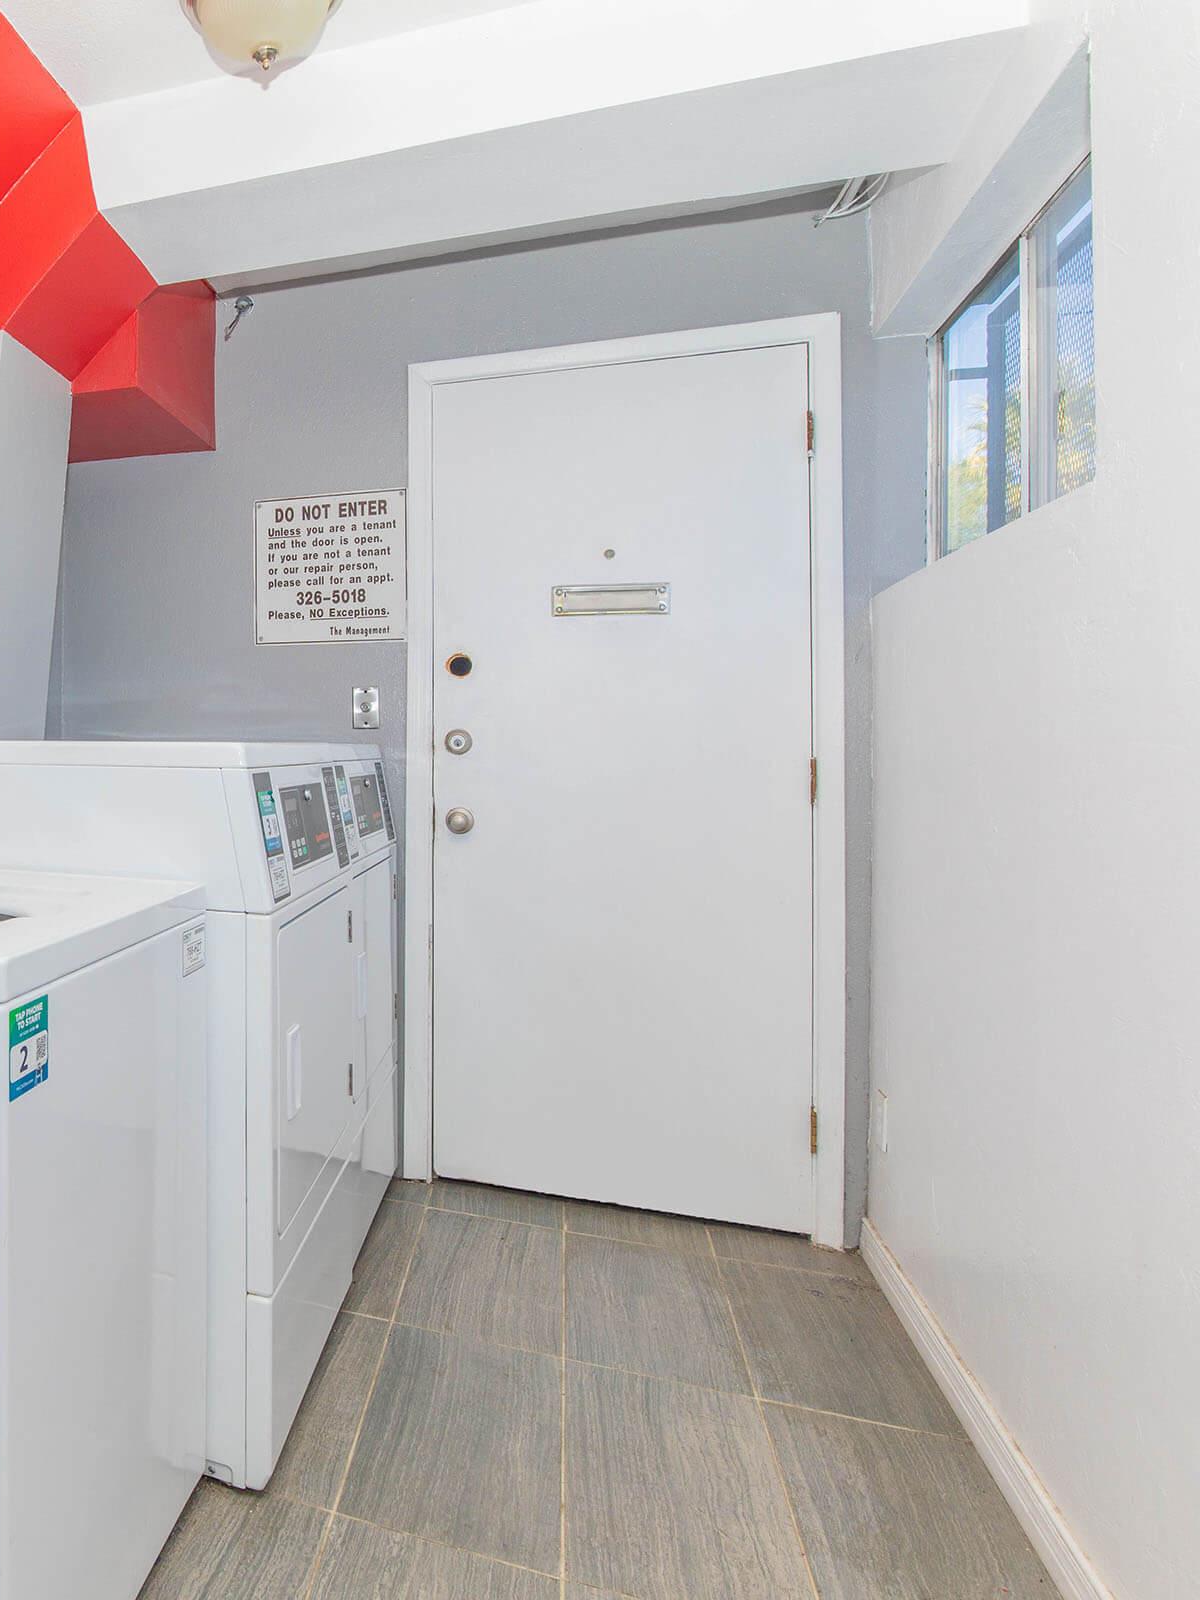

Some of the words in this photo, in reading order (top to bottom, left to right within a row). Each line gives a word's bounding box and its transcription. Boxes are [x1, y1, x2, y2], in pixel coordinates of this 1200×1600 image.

[275, 507, 294, 523] DO
[302, 504, 331, 521] NOT
[338, 499, 388, 518] ENTER
[268, 527, 301, 538] Unless
[306, 526, 324, 537] you
[329, 524, 346, 533] are
[350, 523, 357, 531] a
[362, 519, 397, 531] tenant
[268, 540, 286, 550] and
[291, 539, 307, 549] the
[312, 537, 335, 548] door
[339, 536, 349, 546] is
[354, 535, 383, 546] open.
[268, 553, 275, 563] If
[280, 553, 298, 564] you
[302, 552, 319, 560] are
[323, 549, 340, 560] not
[345, 549, 352, 558] a
[357, 546, 391, 557] tenant
[268, 567, 278, 576] or
[283, 566, 299, 575] our
[304, 563, 334, 575] repair
[338, 561, 378, 573] person,
[268, 578, 301, 590] please
[306, 576, 325, 586] call
[329, 575, 344, 585] for
[349, 575, 362, 584] an
[367, 572, 394, 585] appt.
[296, 588, 367, 606] 326-5018
[268, 610, 305, 621] Please,
[309, 608, 324, 619] NO
[329, 606, 390, 619] Exceptions.
[330, 626, 342, 636] The
[345, 625, 390, 637] Management
[20, 1045, 29, 1073] 2
